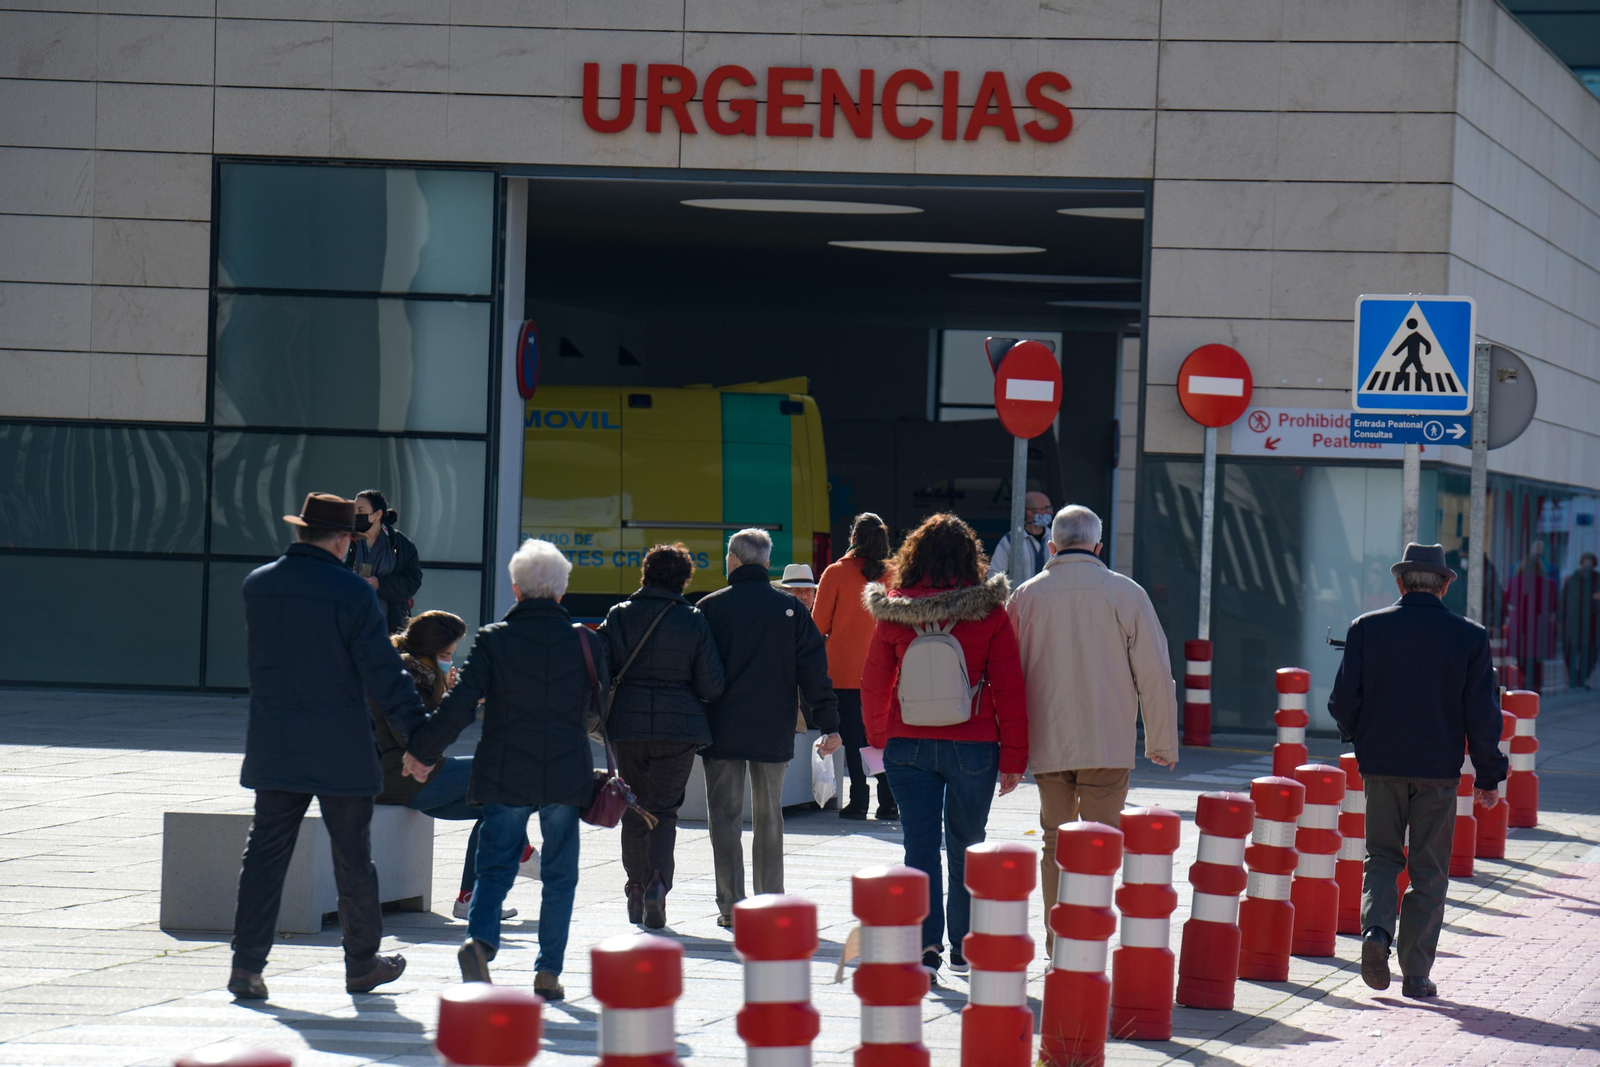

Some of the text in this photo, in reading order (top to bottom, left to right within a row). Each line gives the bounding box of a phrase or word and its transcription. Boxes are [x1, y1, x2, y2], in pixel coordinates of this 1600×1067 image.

[582, 62, 1074, 144] URGENCIAS
[525, 410, 621, 430] MOVIL
[1279, 412, 1351, 429] Prohibido
[1354, 419, 1423, 430] Entrada Peatonal
[1354, 429, 1393, 439] Consultas
[574, 533, 594, 546] DE
